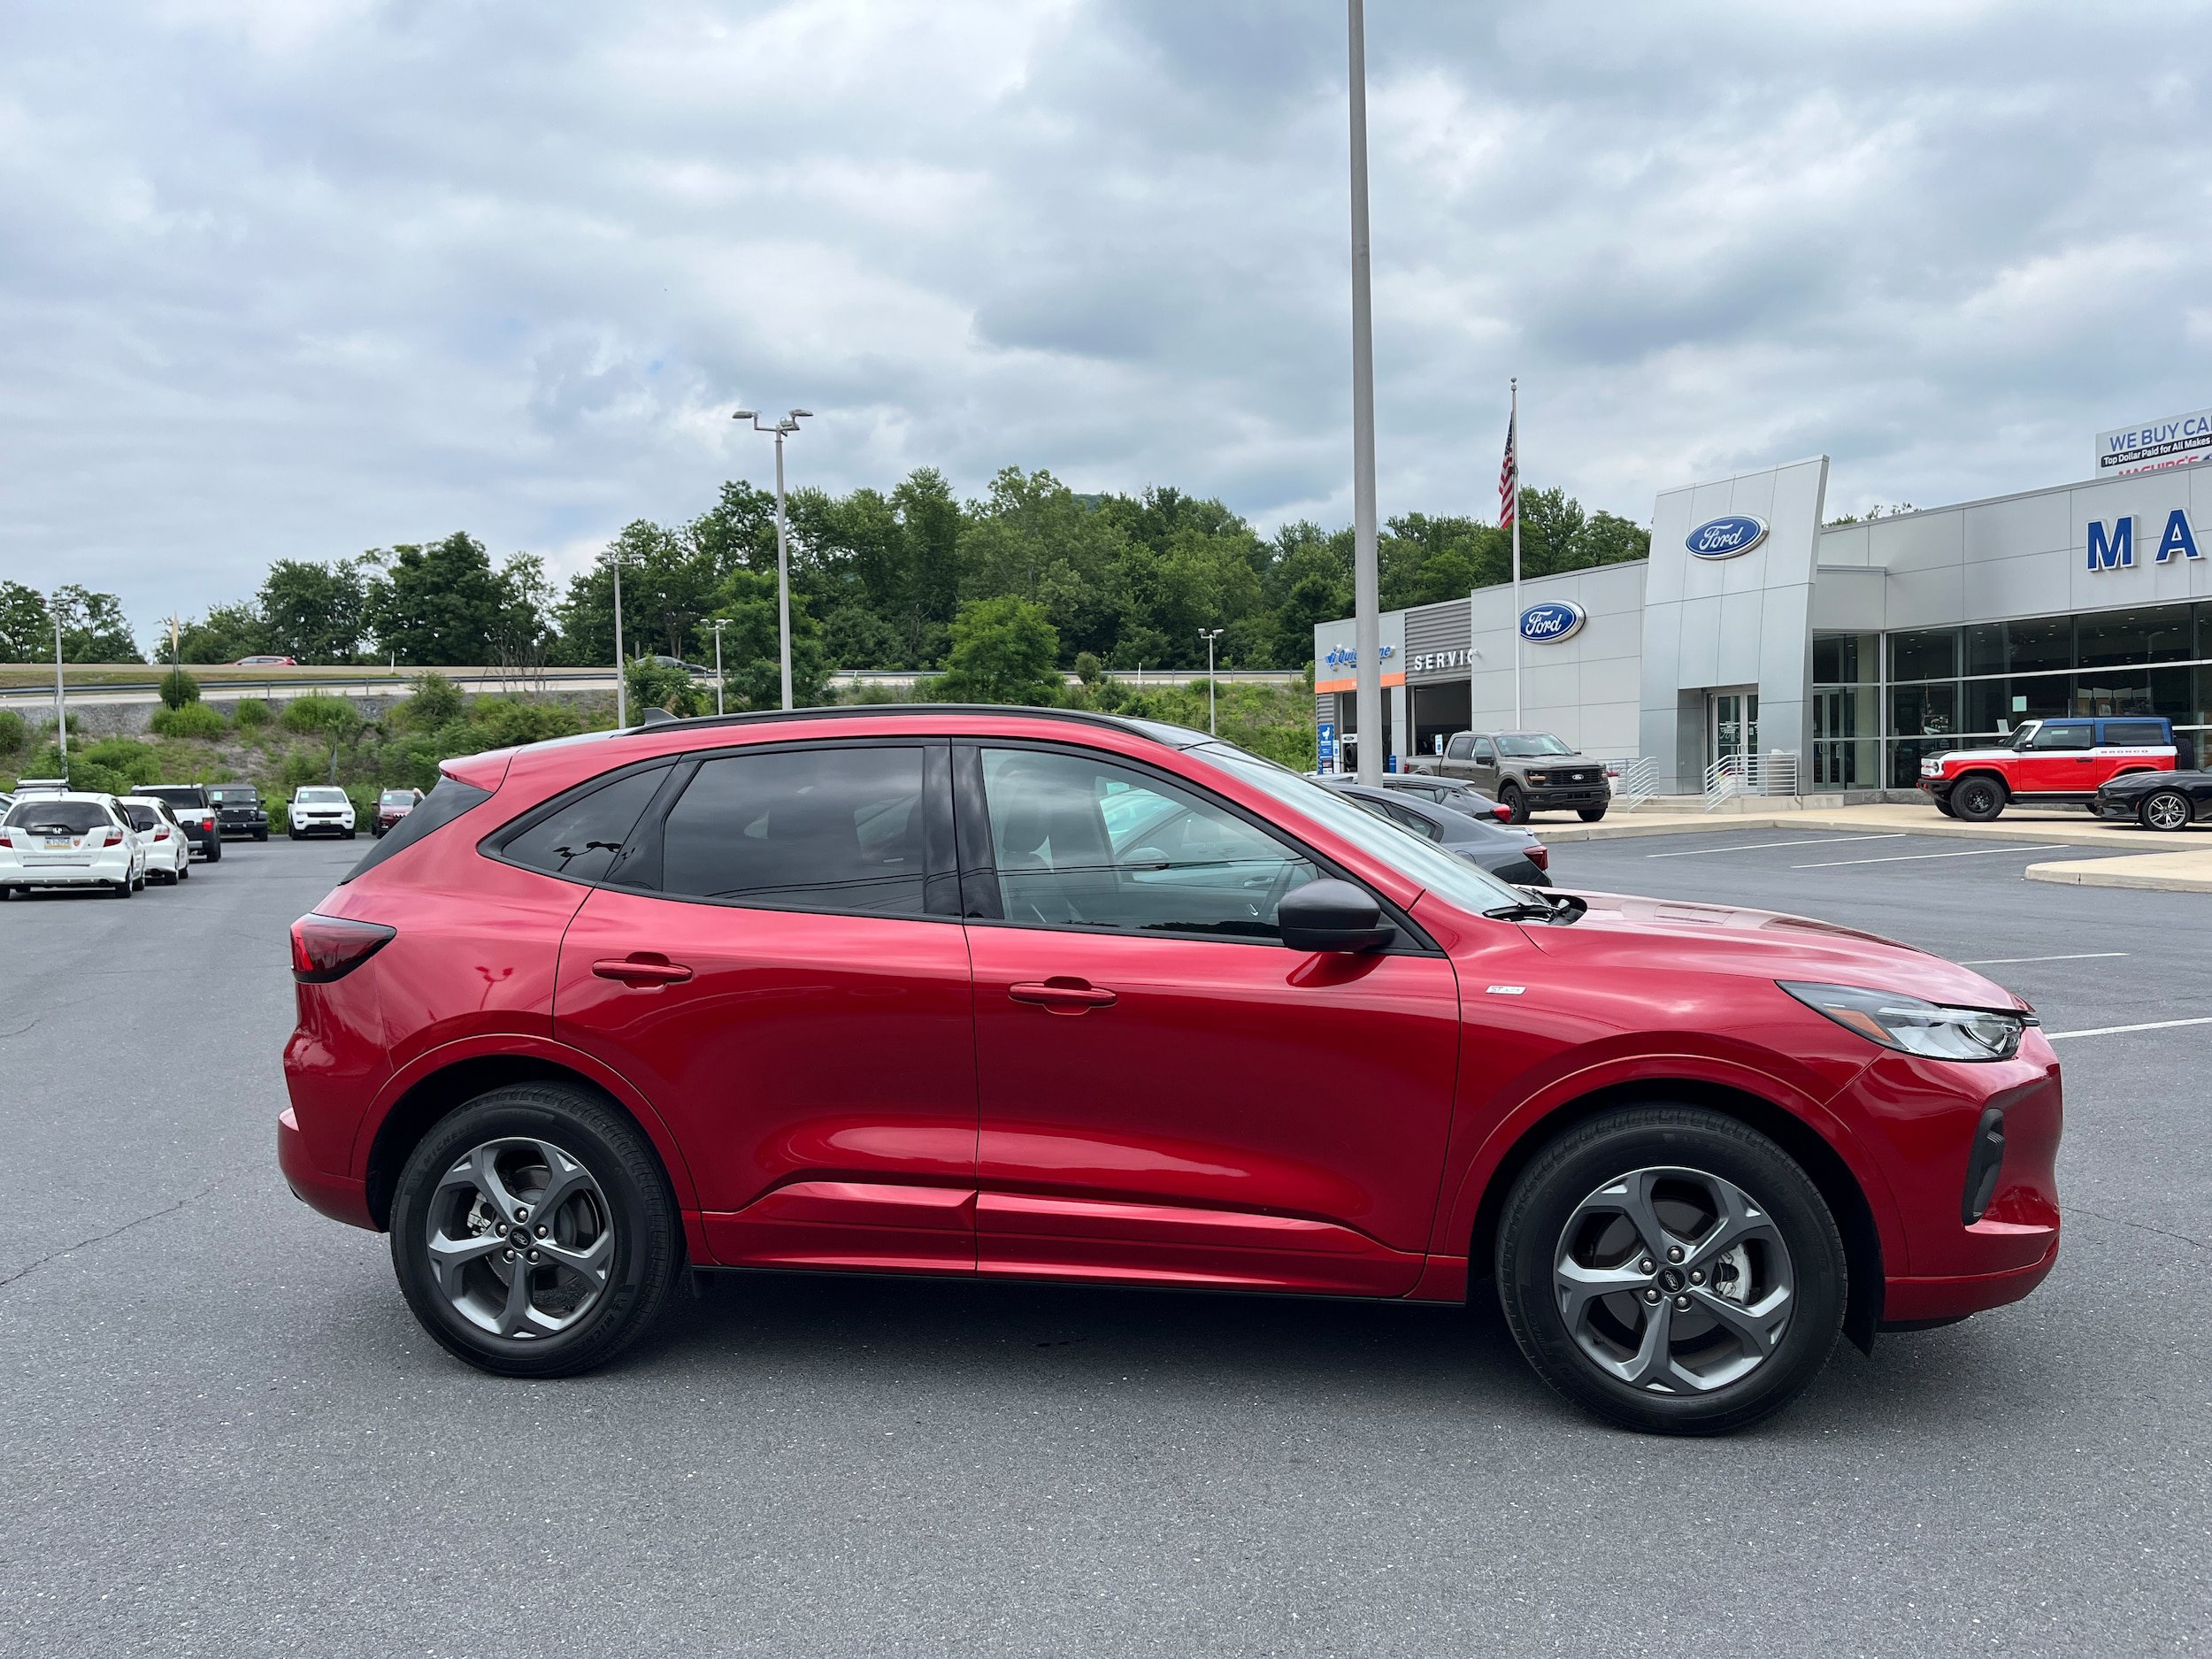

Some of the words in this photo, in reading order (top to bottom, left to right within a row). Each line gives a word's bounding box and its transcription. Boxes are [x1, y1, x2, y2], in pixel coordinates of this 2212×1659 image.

[2109, 432, 2137, 452] WE
[2141, 422, 2180, 446] BUY
[2183, 415, 2212, 436] CA
[2104, 457, 2117, 465] Top
[2118, 451, 2141, 462] Dollar
[2141, 448, 2159, 458] Paid
[2160, 444, 2172, 454] for
[2172, 442, 2184, 451] All
[2185, 437, 2210, 449] Makes
[1699, 524, 1745, 550] Ford
[1525, 610, 1563, 635] Ford
